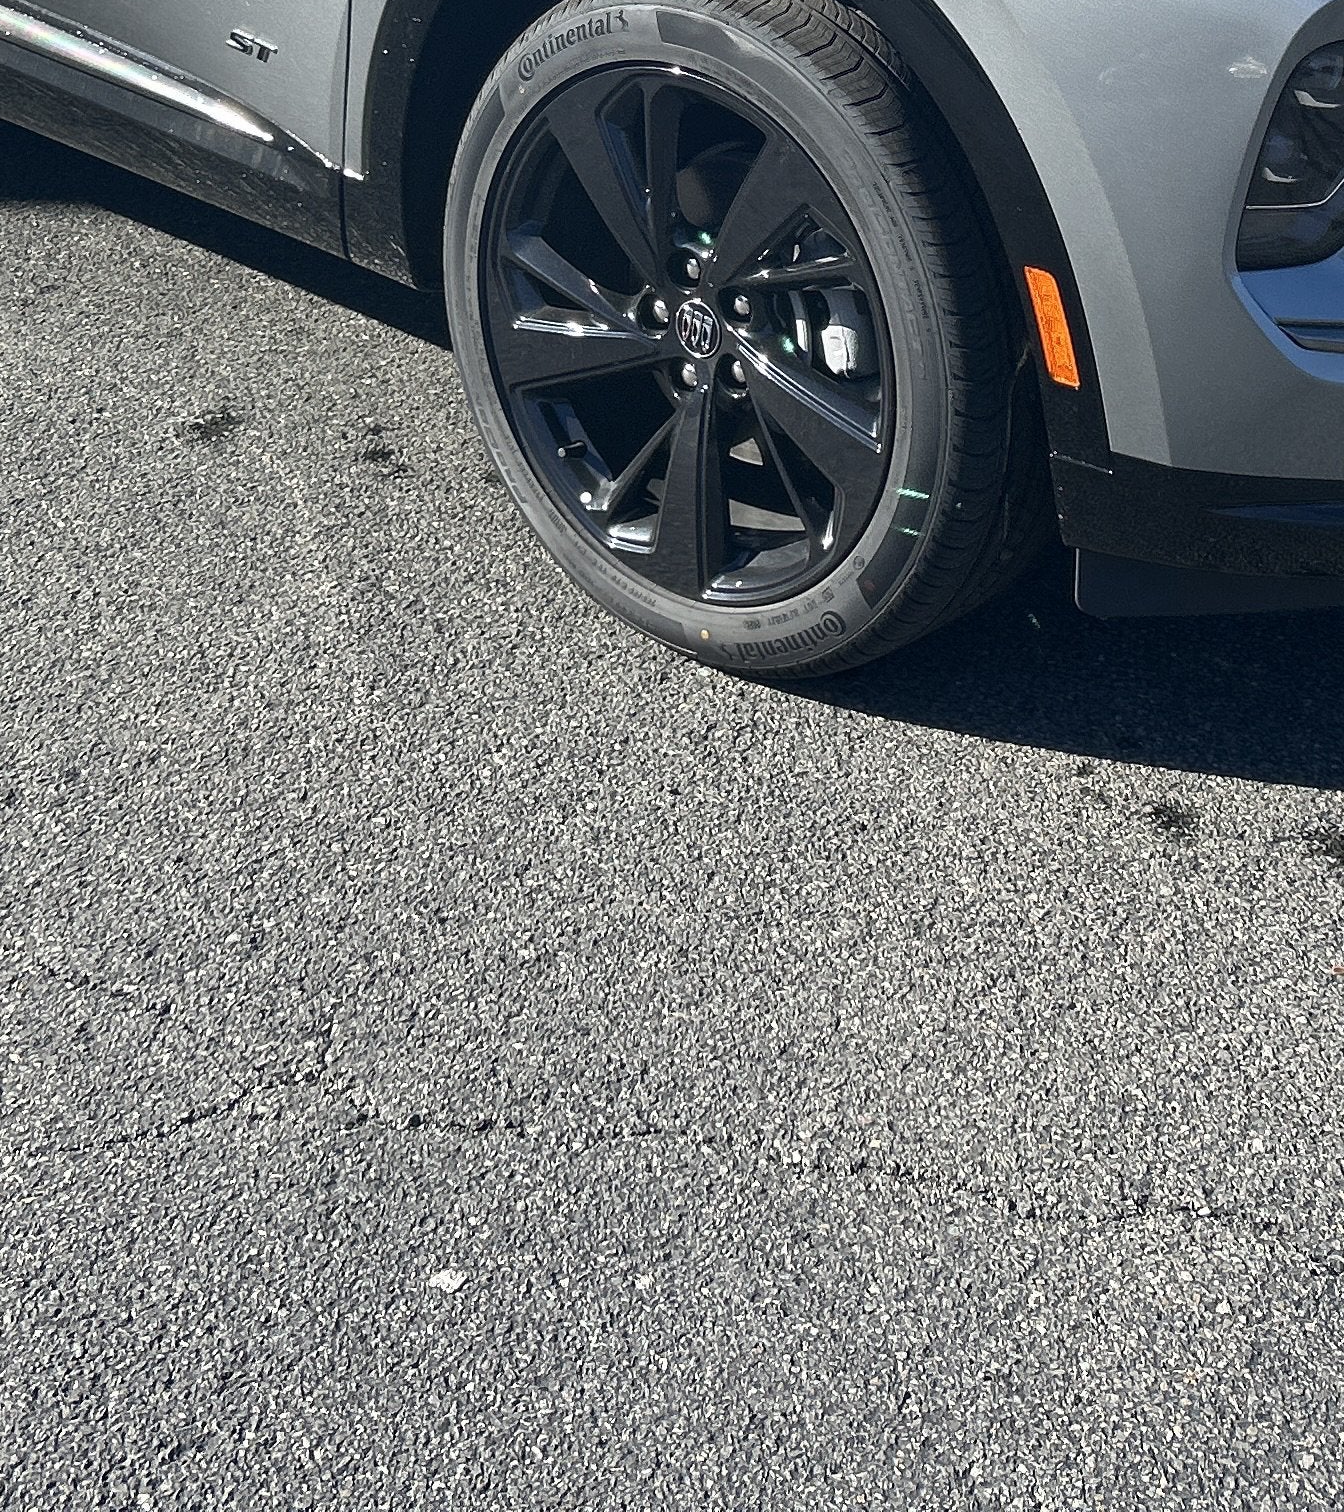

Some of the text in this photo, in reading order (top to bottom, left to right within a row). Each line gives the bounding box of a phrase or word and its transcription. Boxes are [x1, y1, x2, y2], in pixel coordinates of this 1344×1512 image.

[225, 28, 279, 63] ST
[517, 11, 614, 82] Continental
[735, 610, 847, 663] Continental
